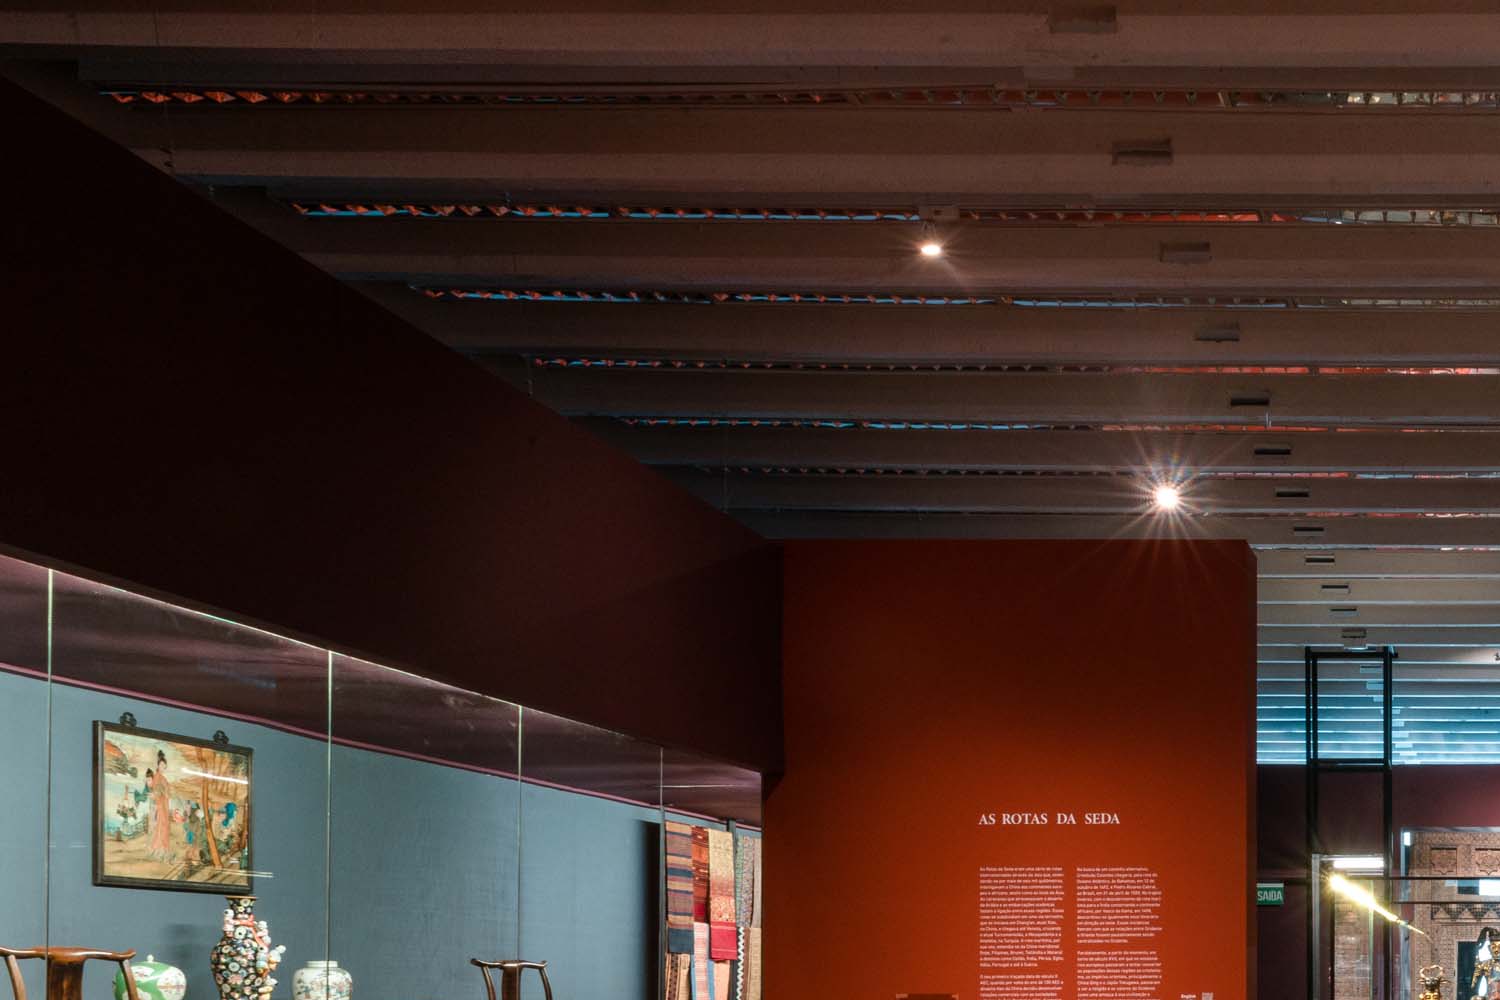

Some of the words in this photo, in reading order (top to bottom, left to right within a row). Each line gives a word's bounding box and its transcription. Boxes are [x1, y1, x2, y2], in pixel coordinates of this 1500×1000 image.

[978, 813, 996, 825] AS
[1001, 813, 1048, 825] ROTAS
[1056, 813, 1077, 825] DA
[1084, 813, 1120, 825] SEDA
